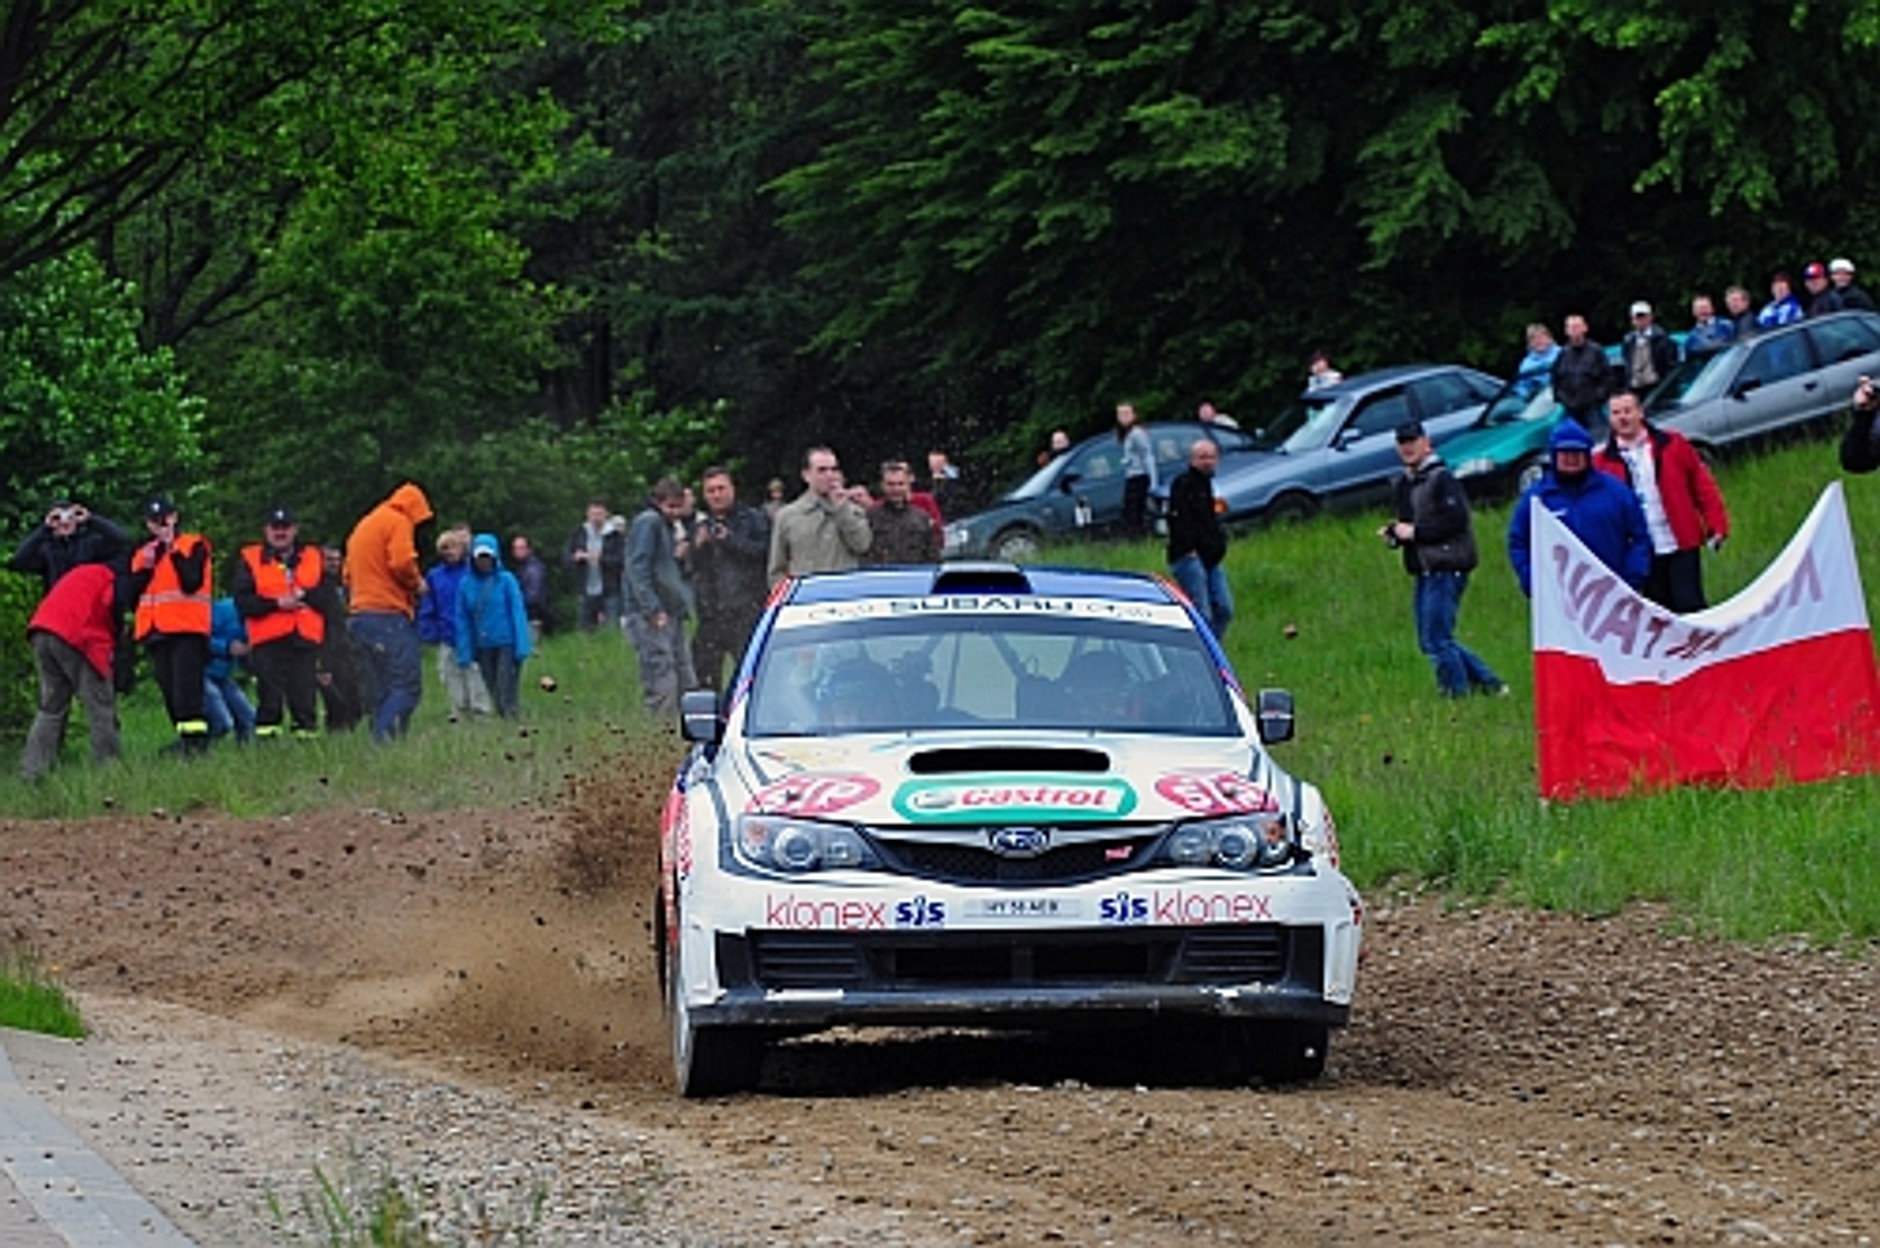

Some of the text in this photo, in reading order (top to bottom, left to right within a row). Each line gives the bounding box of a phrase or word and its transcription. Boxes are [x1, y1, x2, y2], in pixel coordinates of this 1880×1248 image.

[890, 597, 1073, 611] SUBARU
[961, 786, 1107, 807] Castrol
[765, 895, 886, 930] klonex
[1154, 889, 1272, 923] klonex
